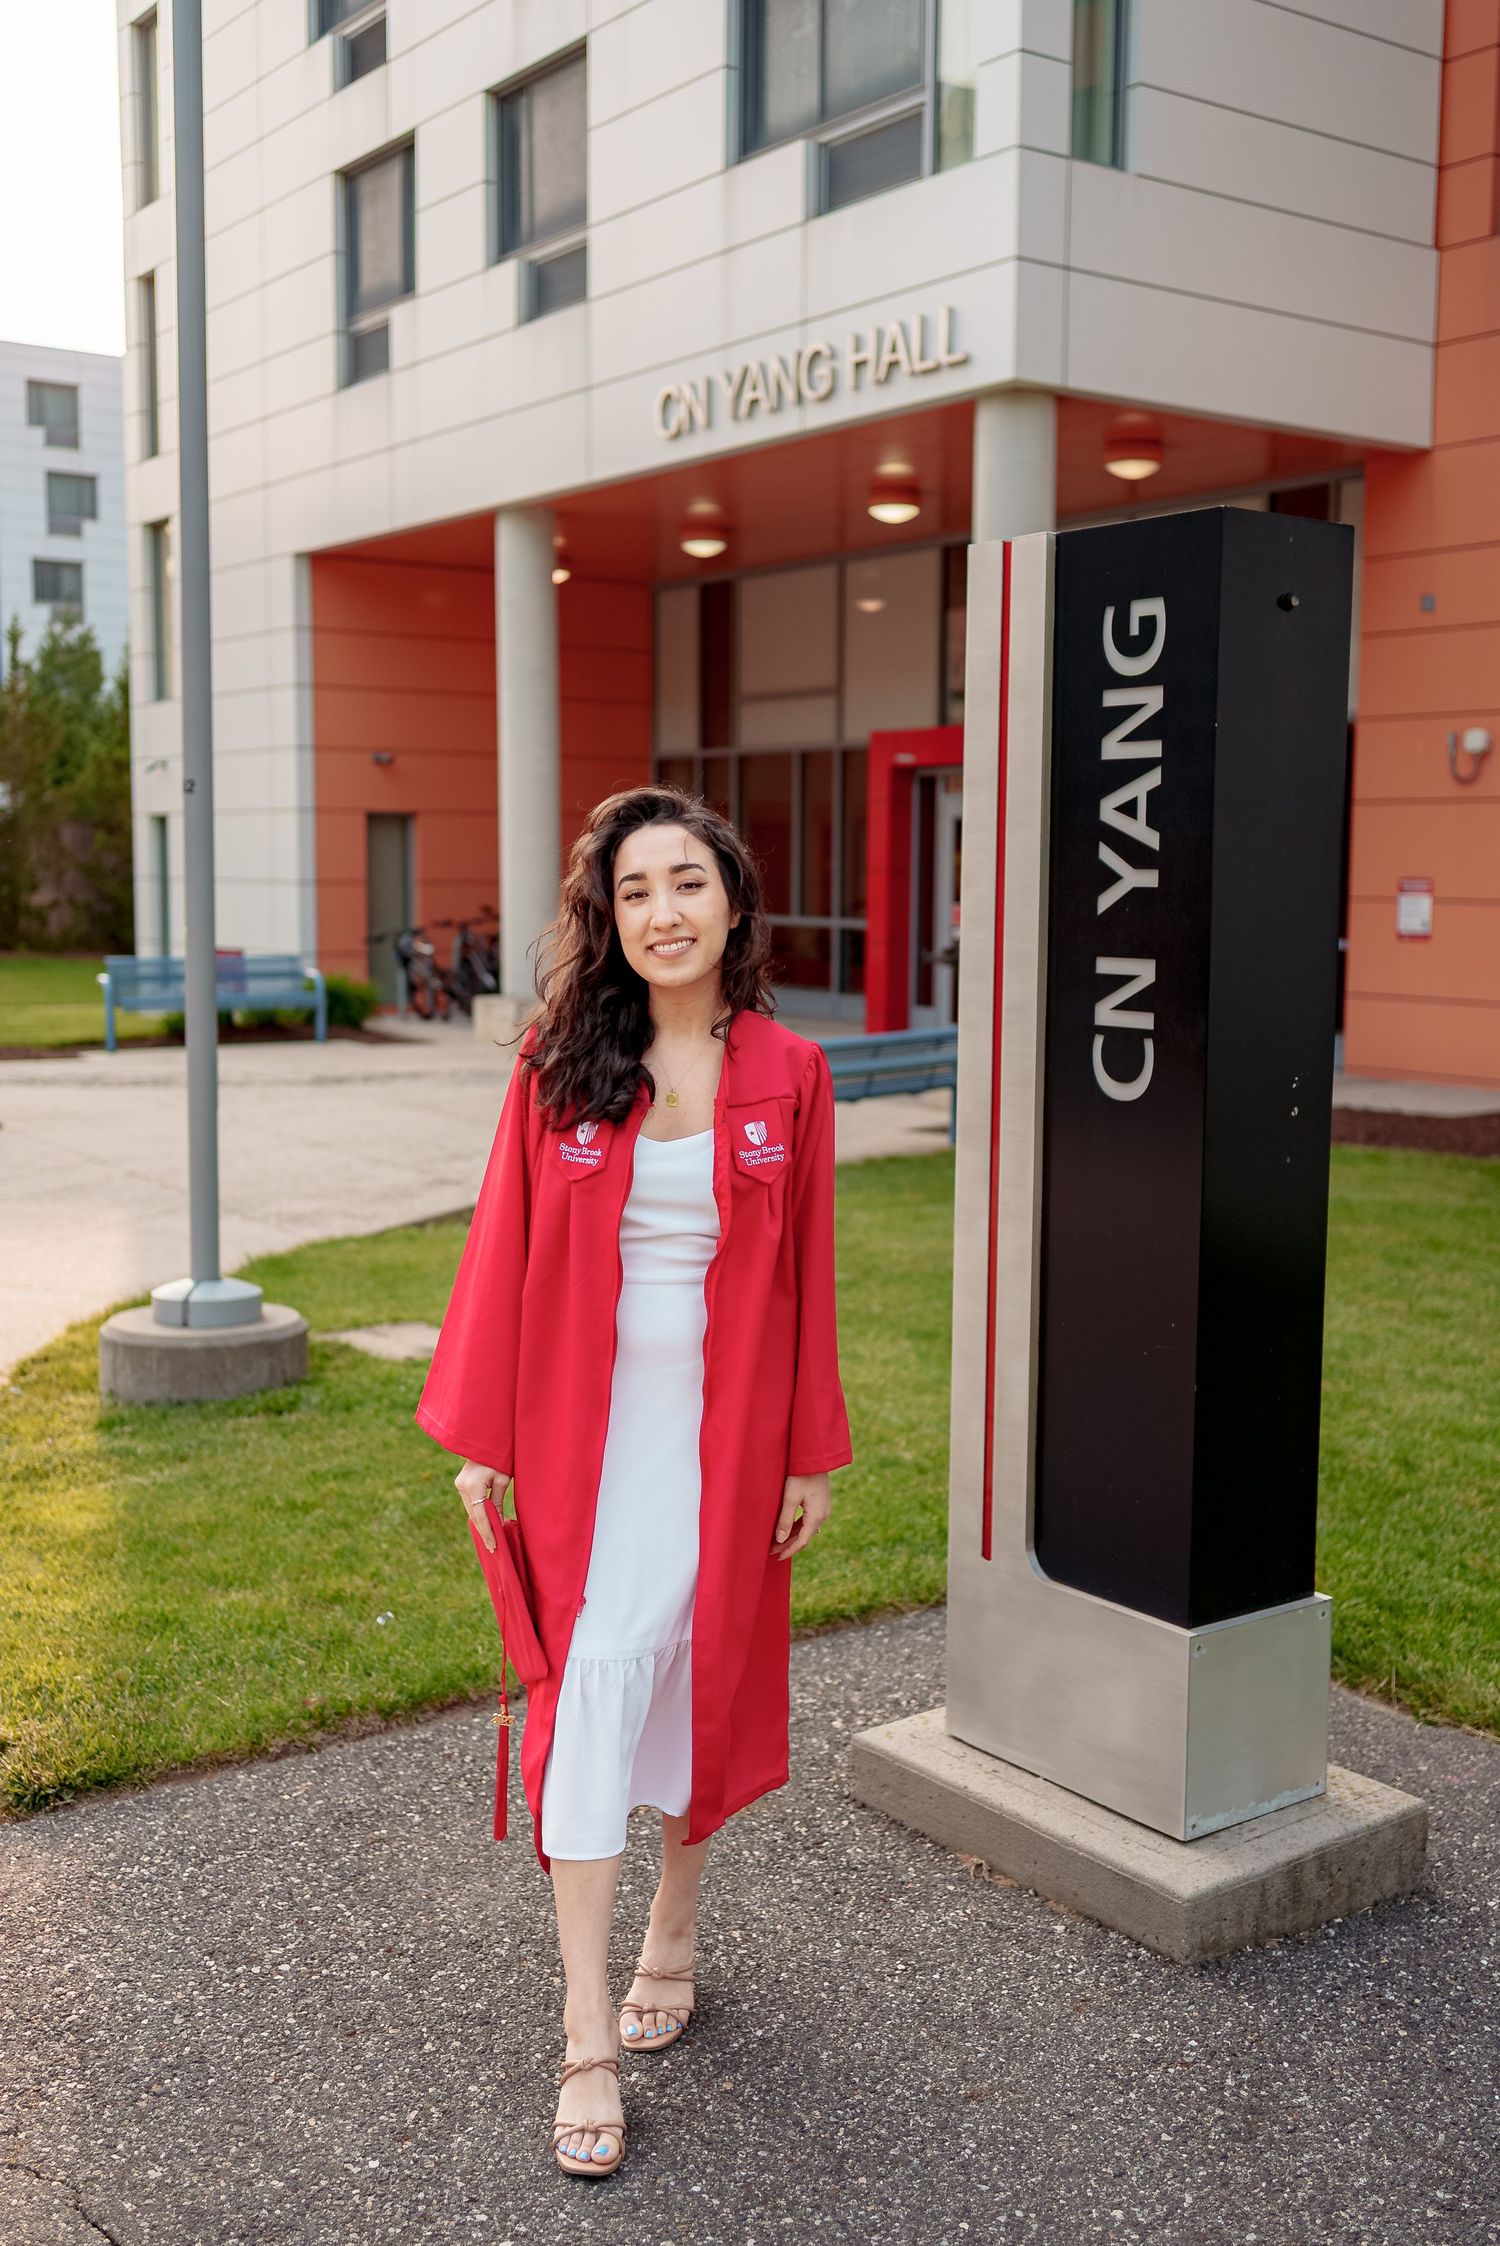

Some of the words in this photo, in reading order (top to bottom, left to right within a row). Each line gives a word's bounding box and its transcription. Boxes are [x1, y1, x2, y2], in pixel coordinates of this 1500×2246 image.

[657, 377, 710, 439] CN
[721, 343, 835, 420] YANG
[847, 305, 968, 390] HALL
[1097, 596, 1166, 916] YANG
[1092, 956, 1155, 1101] CN
[559, 1143, 582, 1157] Stony
[581, 1147, 602, 1157] Brook
[739, 1150, 761, 1159] Stony
[761, 1143, 784, 1155] Brook
[562, 1152, 599, 1166] University
[745, 1153, 784, 1166] University
